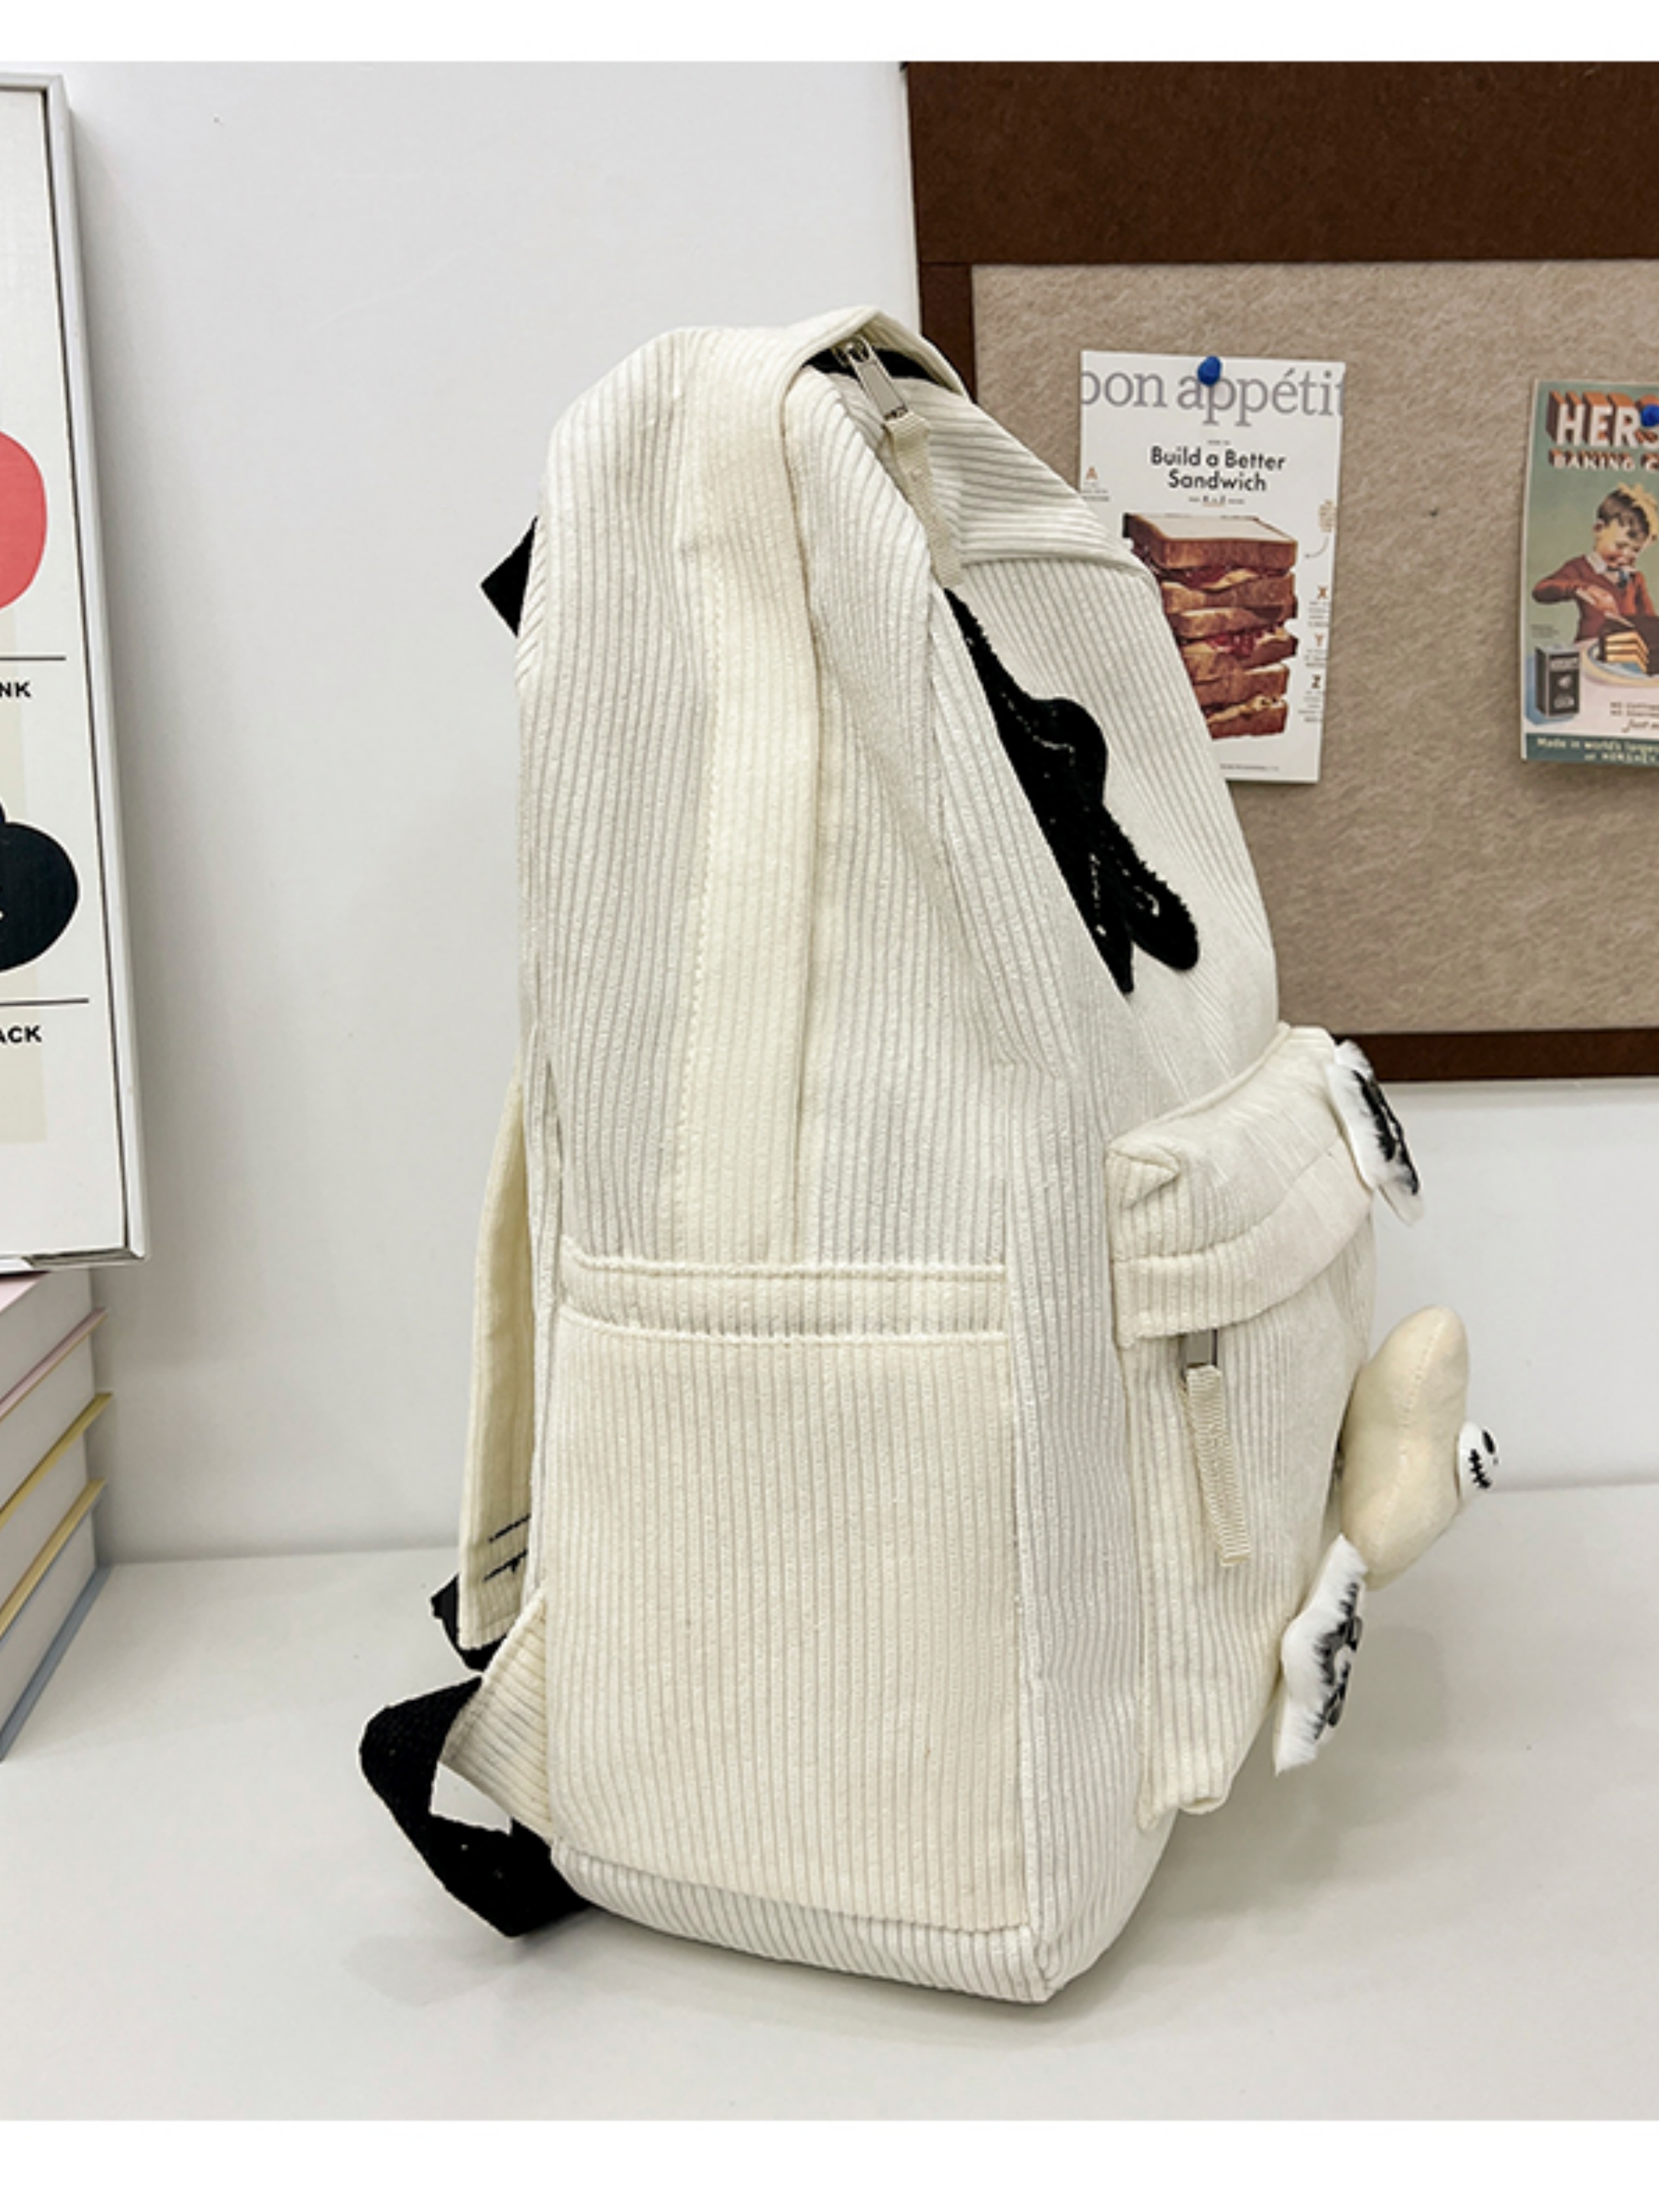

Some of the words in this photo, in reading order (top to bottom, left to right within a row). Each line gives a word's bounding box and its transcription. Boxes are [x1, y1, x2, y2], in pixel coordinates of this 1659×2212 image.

[1151, 445, 1201, 467] Build
[1206, 453, 1219, 468] a
[1224, 448, 1286, 471] Better
[1167, 468, 1267, 492] Sandwich
